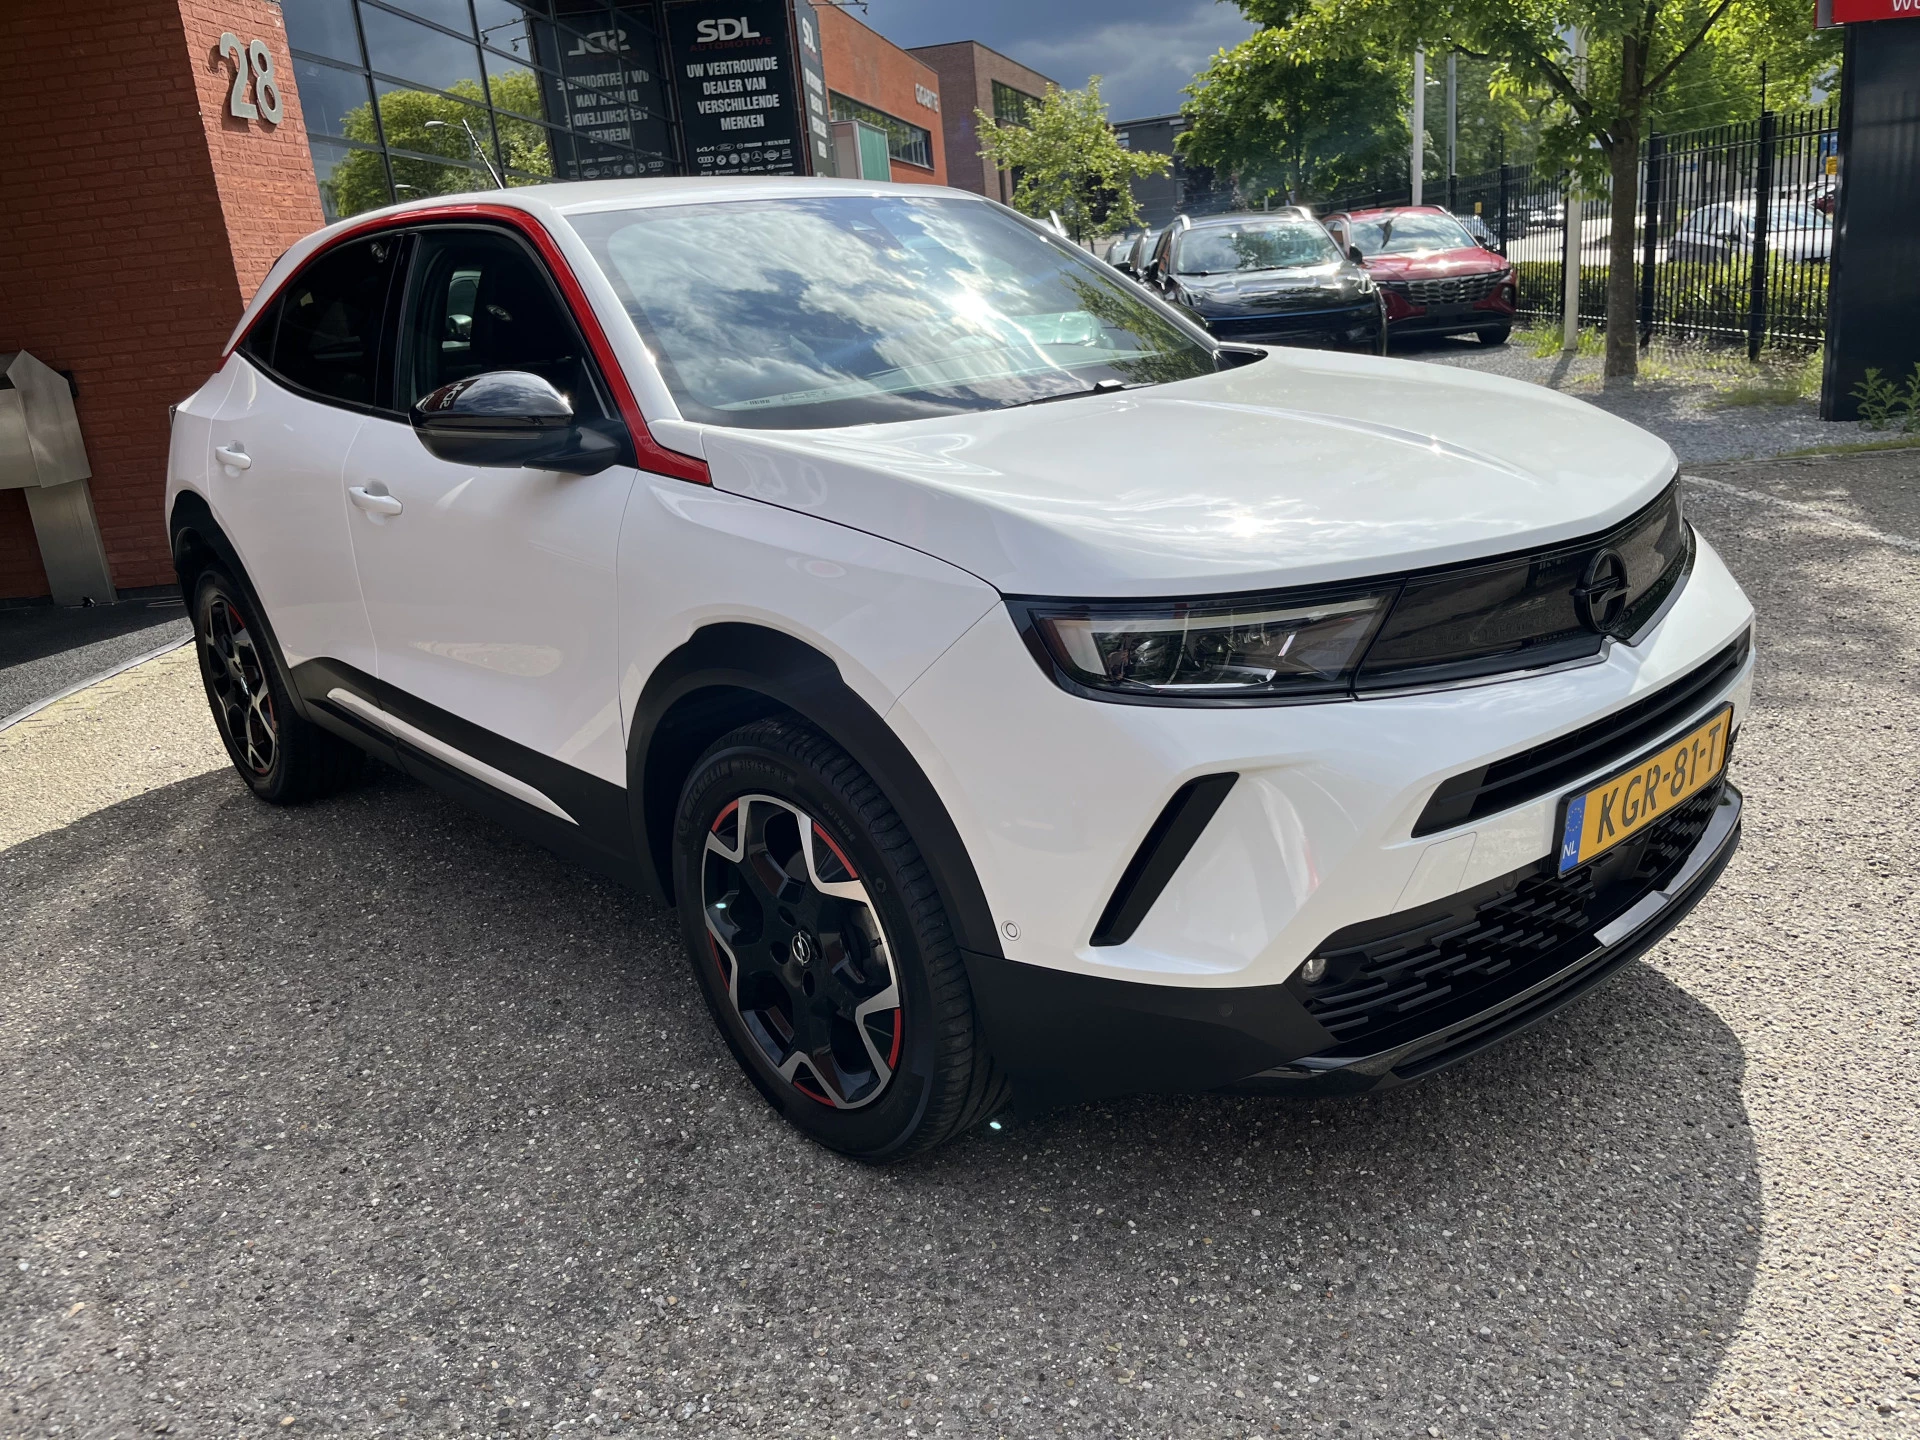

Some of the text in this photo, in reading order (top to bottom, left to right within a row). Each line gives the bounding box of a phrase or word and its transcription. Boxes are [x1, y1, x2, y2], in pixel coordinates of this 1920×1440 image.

[697, 17, 760, 43] SDL
[690, 37, 772, 52] AUTOMOTIVE
[686, 56, 778, 78] UW VERTROUWDE
[219, 32, 284, 125] 28
[702, 76, 767, 95] DEALER VAN
[697, 94, 780, 114] VERSCHILLENDE
[720, 114, 765, 131] MERKEN
[1597, 722, 1721, 844] KGR-81-T
[823, 803, 856, 841] OUTSIDE
[1562, 840, 1577, 859] NL
